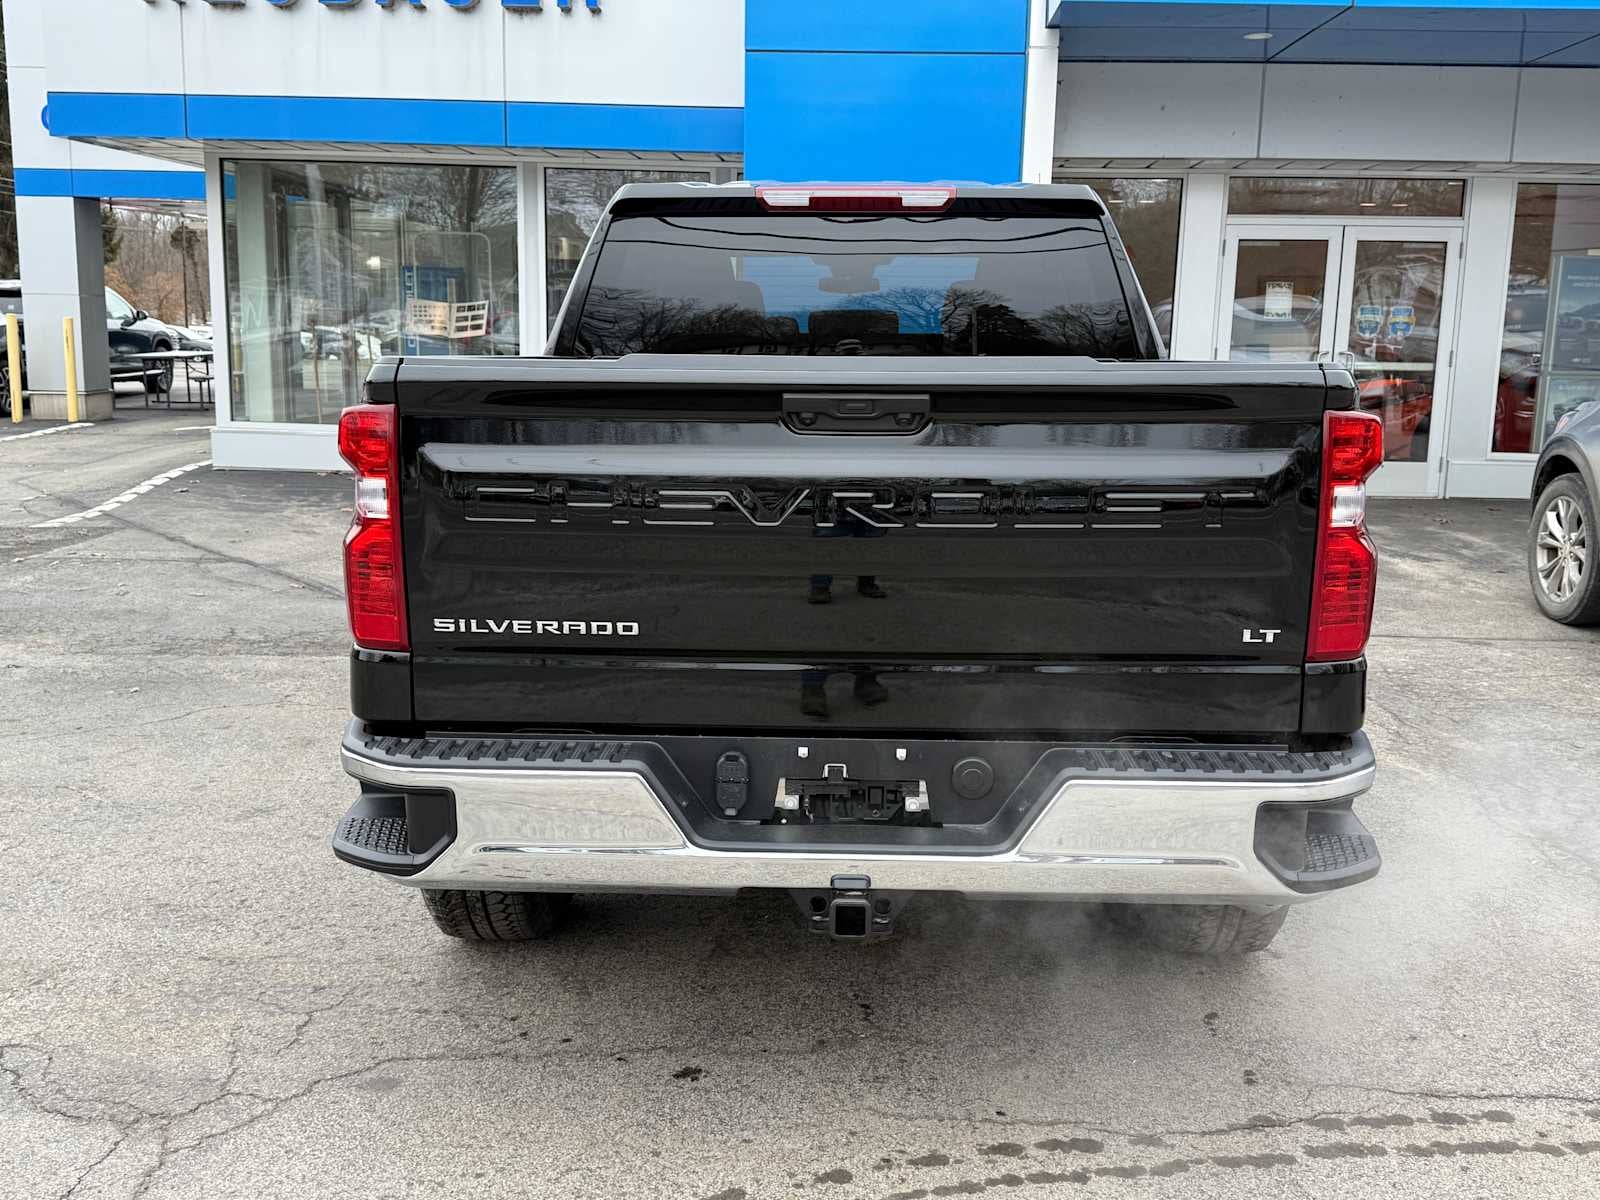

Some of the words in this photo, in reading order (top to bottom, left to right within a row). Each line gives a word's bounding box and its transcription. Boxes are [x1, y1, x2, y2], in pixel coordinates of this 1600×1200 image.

[463, 483, 1260, 529] CHEVROLET
[432, 617, 641, 637] SILVERADO
[1242, 628, 1282, 644] LT
